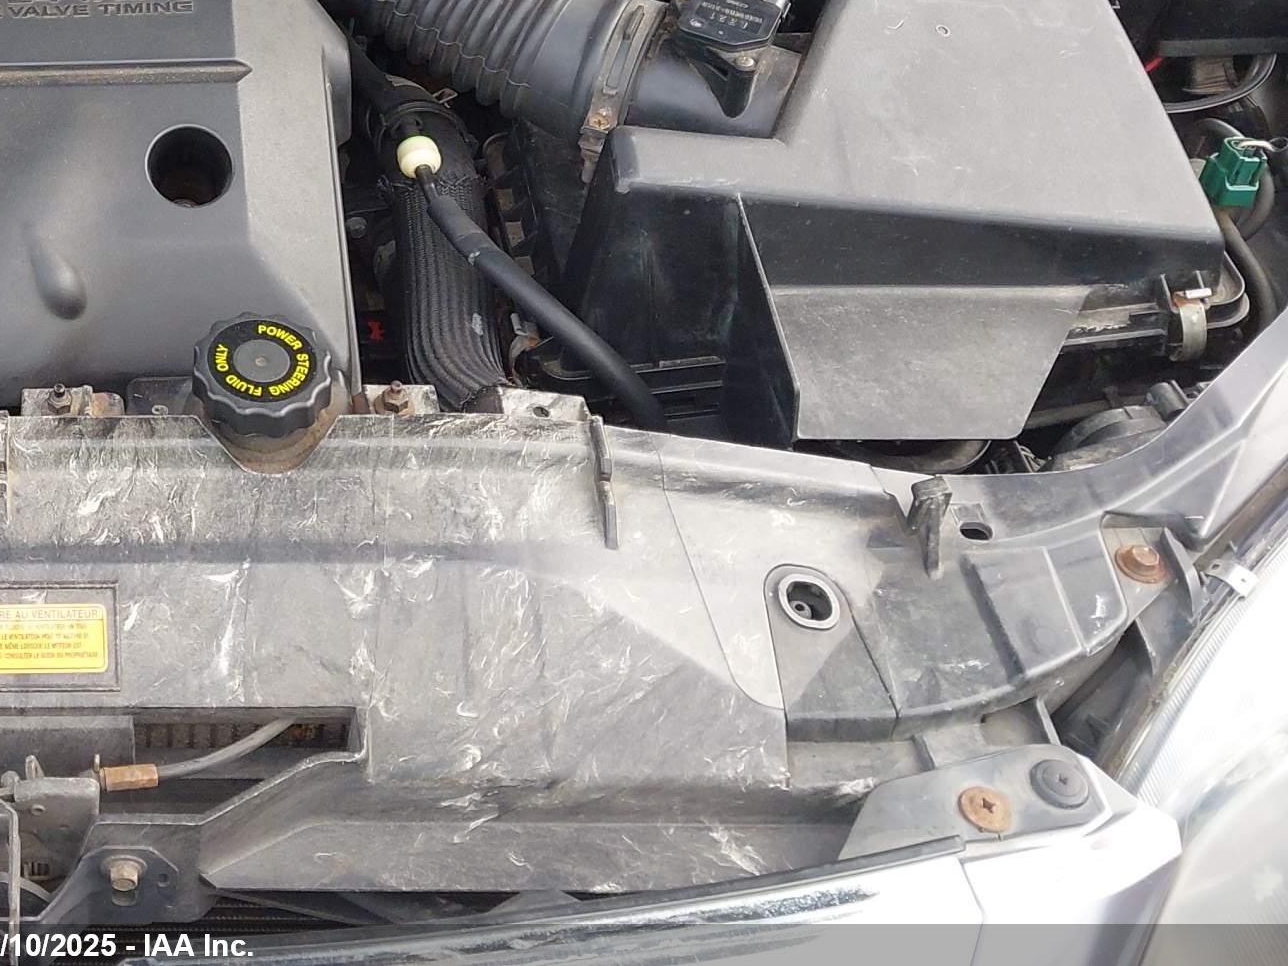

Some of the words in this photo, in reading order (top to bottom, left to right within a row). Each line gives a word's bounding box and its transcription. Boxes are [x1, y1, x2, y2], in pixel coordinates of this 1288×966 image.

[10, 4, 90, 17] VALVE
[98, 0, 193, 16] TIMING
[258, 324, 303, 351] POWER
[215, 344, 229, 372] ONLY
[225, 374, 263, 397] FLUID
[267, 353, 310, 396] STEERING
[15, 609, 29, 619] AU
[32, 609, 99, 619] VENTILATEUR
